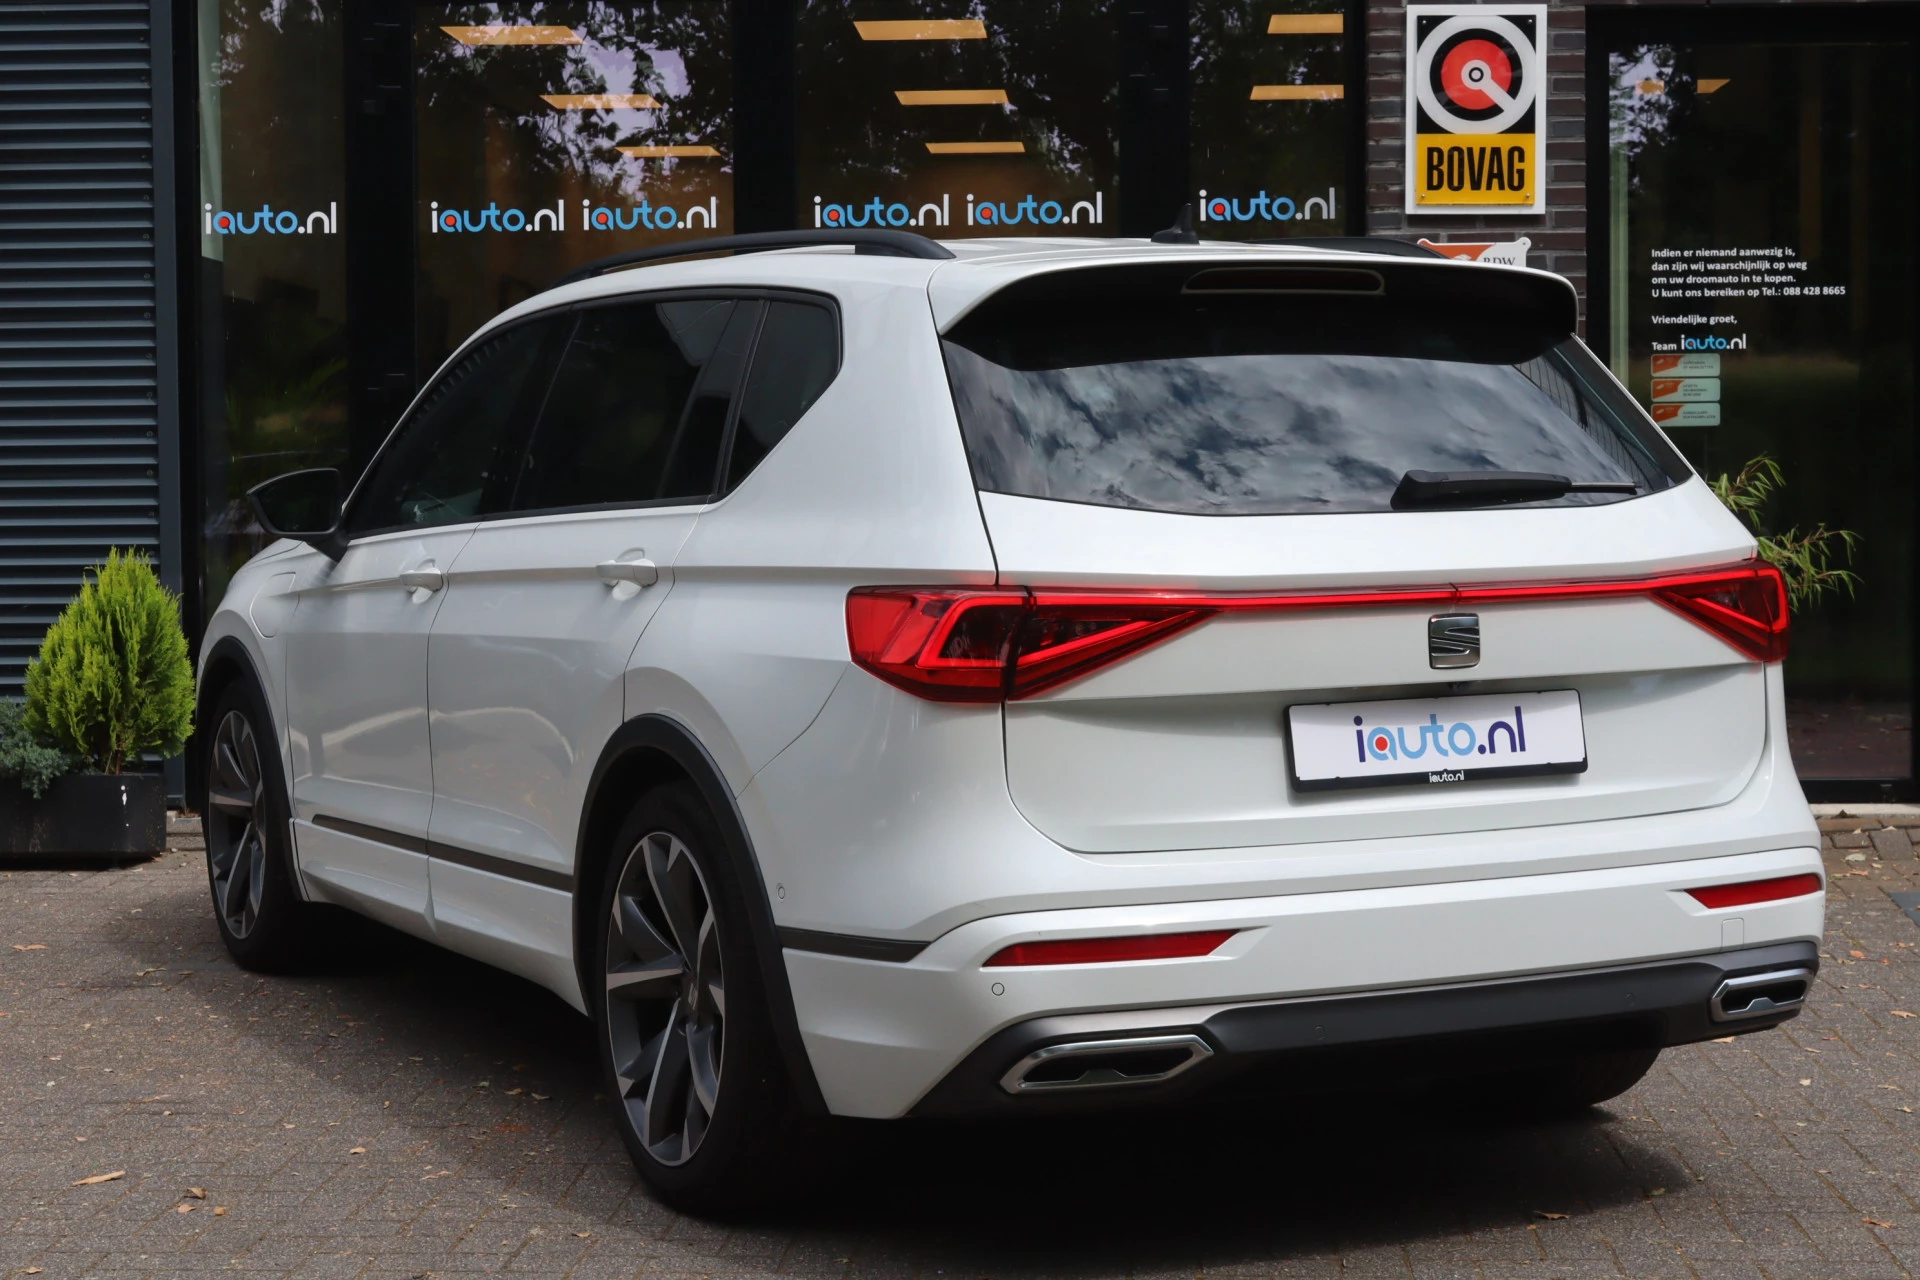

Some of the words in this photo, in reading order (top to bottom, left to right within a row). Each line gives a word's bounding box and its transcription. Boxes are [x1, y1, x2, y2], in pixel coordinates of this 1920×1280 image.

[1426, 146, 1525, 192] BOVAG
[204, 201, 337, 236] iauto.nl
[430, 199, 565, 233] iauto.nl
[582, 196, 717, 231] iauto.nl
[813, 193, 950, 228] iauto.nl
[966, 191, 1103, 226] iauto.nl
[1199, 187, 1336, 222] iauto.nl
[1651, 248, 1681, 258] Indien
[1695, 247, 1737, 257] niemand
[1739, 246, 1783, 258] aanwezig
[1785, 246, 1796, 257] is,
[1651, 261, 1669, 271] dan
[1671, 261, 1688, 273] zijn
[1690, 261, 1705, 272] wij
[1706, 259, 1771, 272] waarschijnlijk
[1772, 261, 1786, 271] op
[1787, 261, 1808, 271] weg
[1651, 288, 1659, 298] U
[1661, 288, 1683, 298] kunt
[1684, 289, 1702, 297] ons
[1704, 287, 1745, 297] bereiken
[1747, 288, 1760, 298] op
[1761, 286, 1781, 297] Tel.:
[1783, 286, 1801, 296] 088
[1802, 286, 1821, 296] 428
[1822, 286, 1846, 296] 8665
[1686, 274, 1739, 284] droomauto
[1741, 273, 1750, 283] in
[1752, 274, 1762, 283] te
[1764, 273, 1797, 284] kopen.
[1651, 314, 1708, 326] Vriendelijke
[1709, 314, 1738, 326] groet,
[1651, 341, 1678, 351] Team
[1680, 333, 1747, 351] iauto.nl
[1353, 705, 1526, 763] iauto.nl
[1428, 769, 1465, 784] iauto.nl
